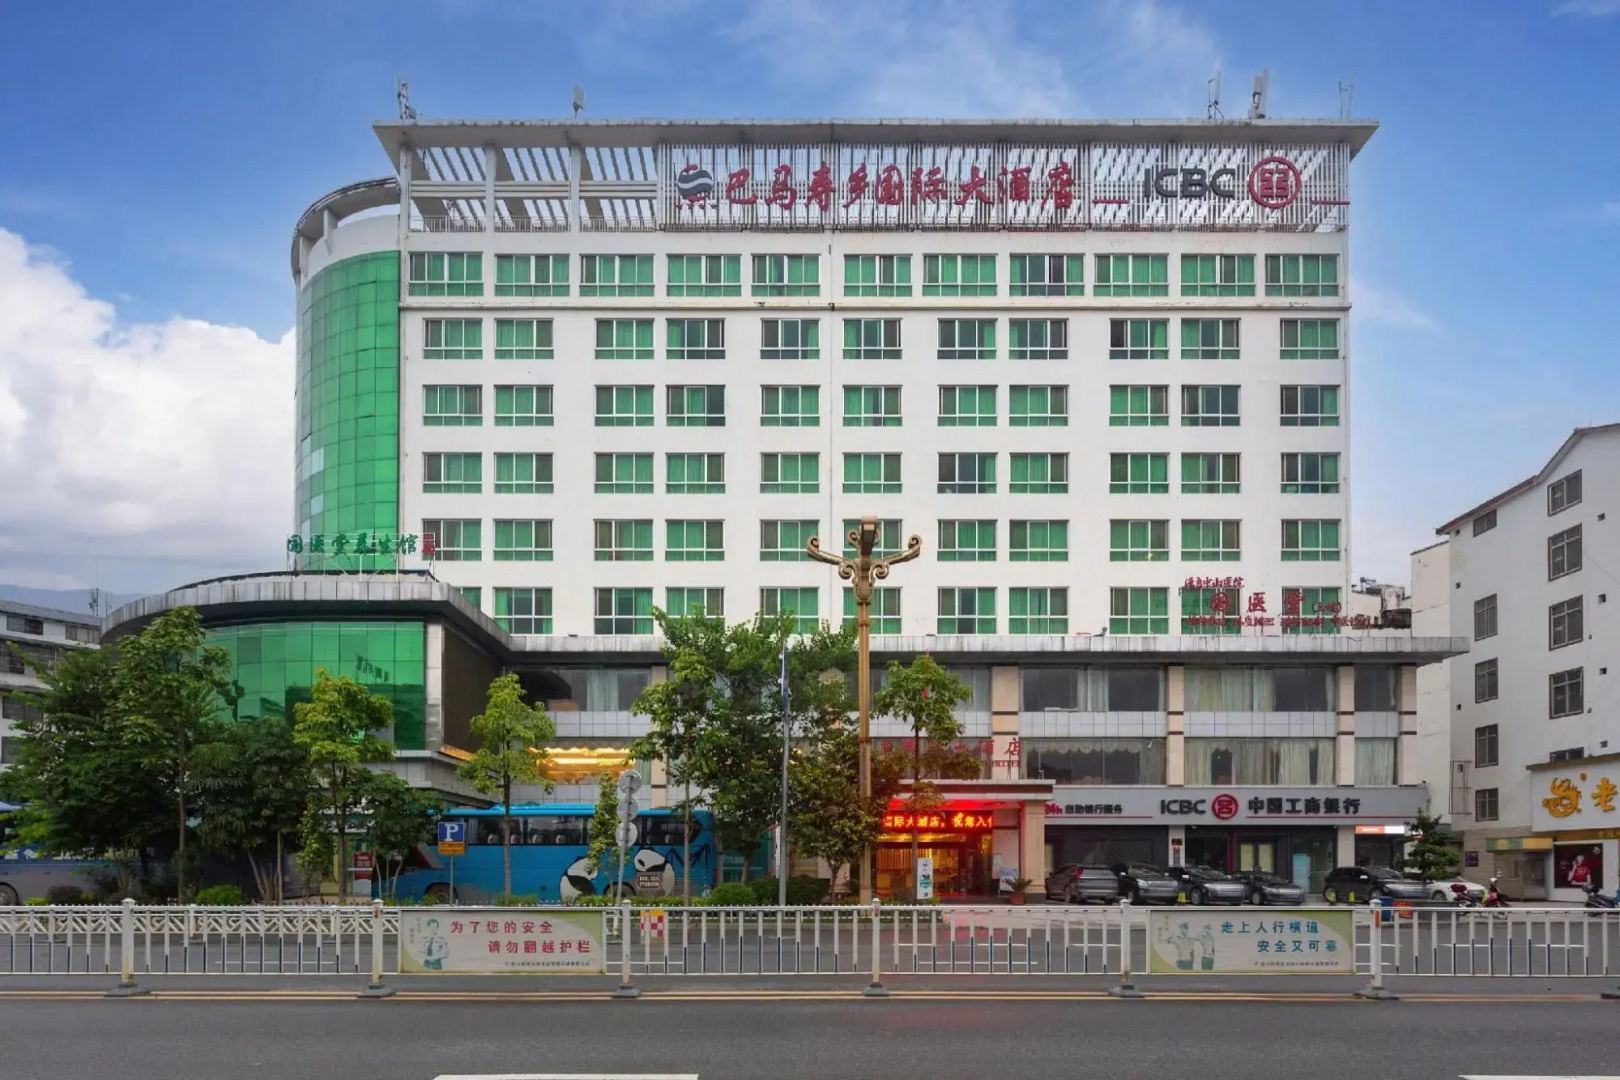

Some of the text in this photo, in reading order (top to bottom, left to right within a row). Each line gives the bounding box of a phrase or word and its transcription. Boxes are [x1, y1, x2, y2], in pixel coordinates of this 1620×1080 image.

[1143, 168, 1236, 198] ICBC
[1160, 799, 1207, 815] ICBC
[1248, 797, 1361, 815] 中国工商银行
[444, 823, 459, 842] P
[450, 921, 553, 934] 为了您的安全
[1221, 921, 1319, 934] 走上人行横道
[488, 940, 591, 954] 请勿翻越护栏
[1257, 940, 1338, 953] 安全又可靠
